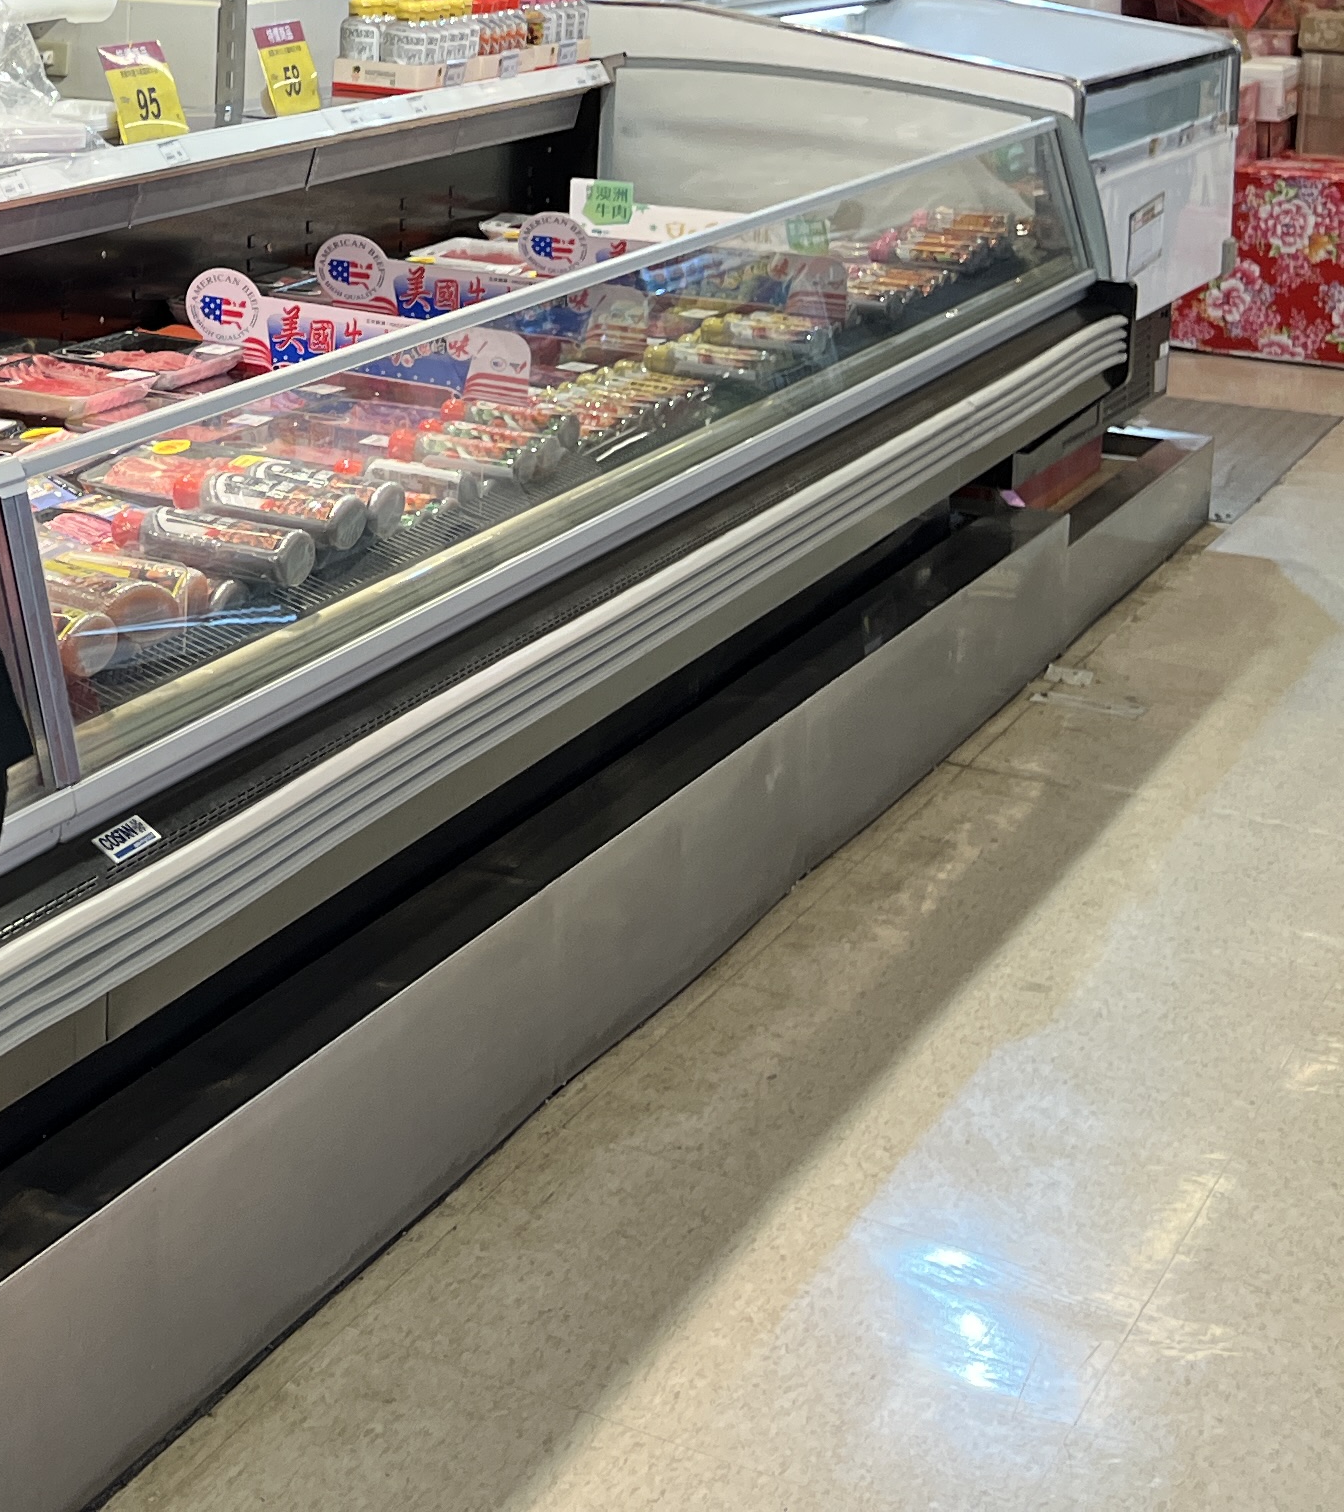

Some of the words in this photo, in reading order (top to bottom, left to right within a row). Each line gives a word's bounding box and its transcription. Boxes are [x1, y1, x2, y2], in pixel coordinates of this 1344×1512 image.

[136, 87, 161, 121] 95
[595, 203, 627, 220] 牛肉
[319, 240, 366, 269] AMERICAN
[191, 273, 241, 302] AMERICAN
[241, 284, 260, 315] BEEF
[215, 327, 251, 341] QUALITY
